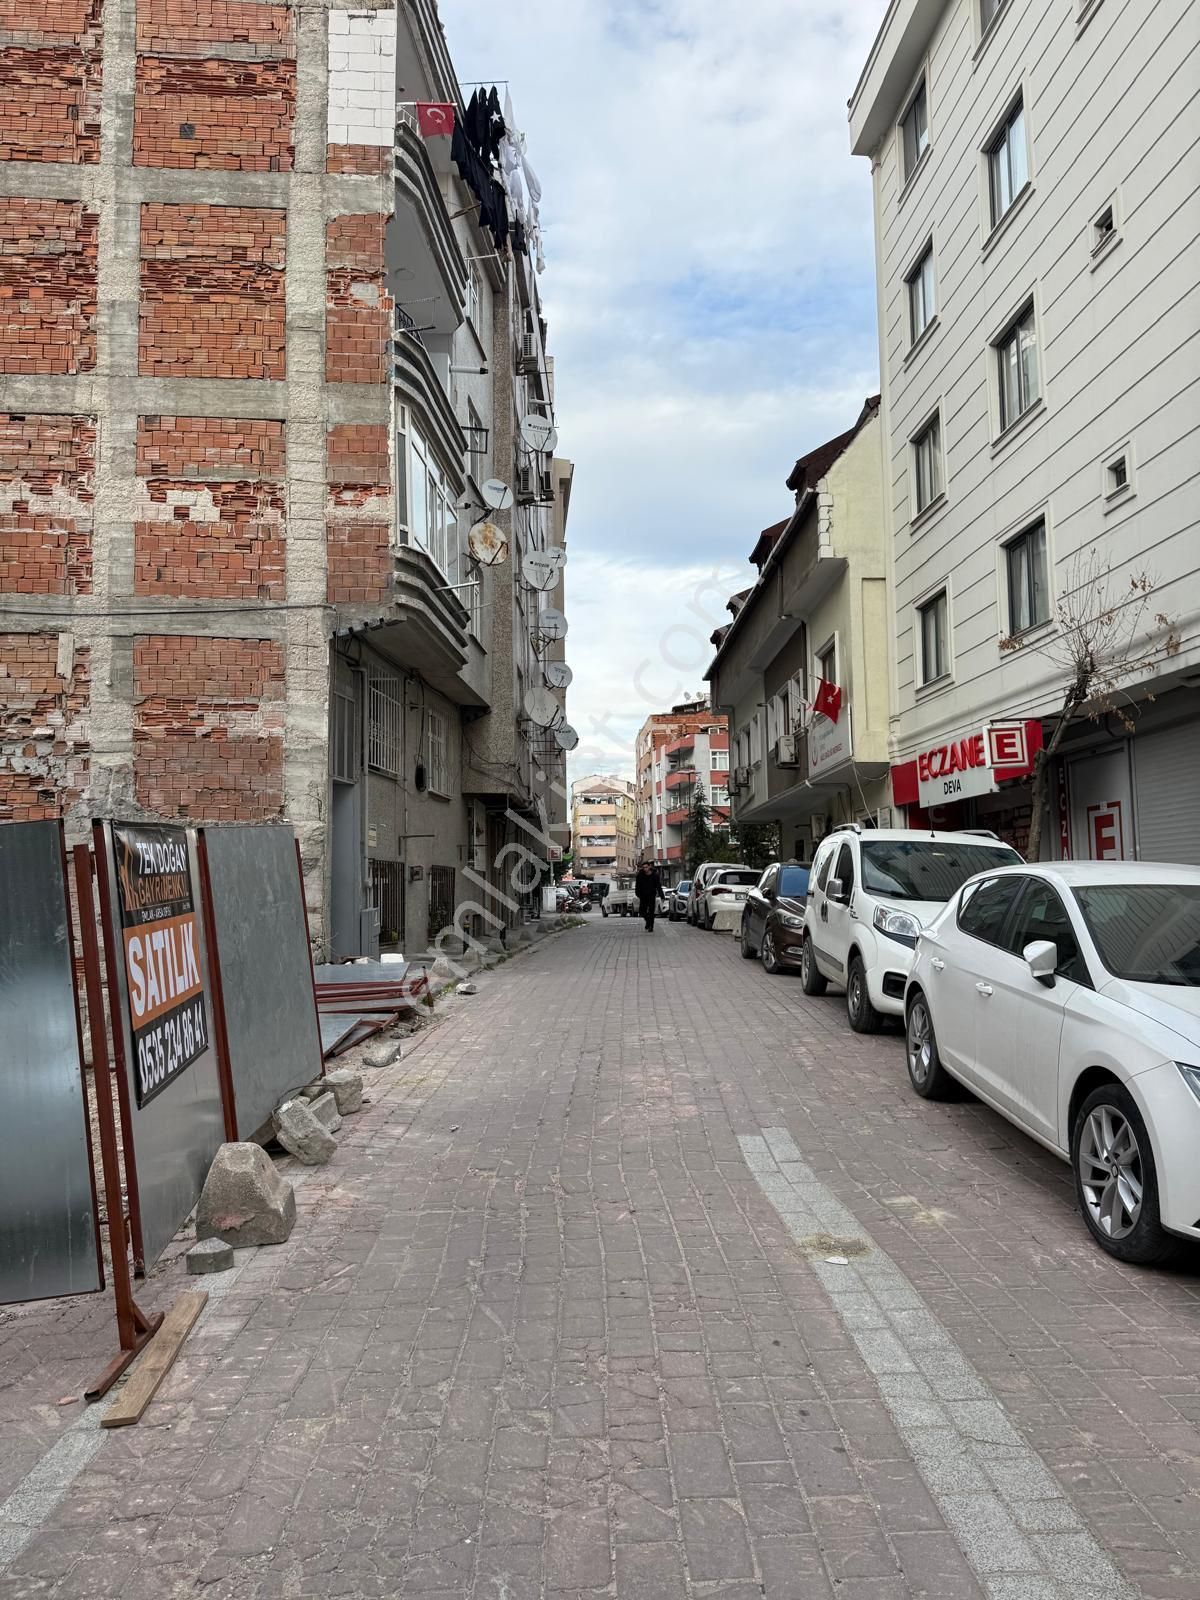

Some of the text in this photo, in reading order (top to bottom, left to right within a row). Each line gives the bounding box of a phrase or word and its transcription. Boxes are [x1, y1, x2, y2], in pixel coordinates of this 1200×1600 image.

[918, 733, 986, 782] ECZANE
[996, 733, 1018, 760] E
[943, 779, 962, 795] DEVA
[136, 838, 187, 875] TEK DOĞAN
[128, 922, 200, 1017] SATILIK
[138, 1027, 165, 1094] 0535
[164, 1014, 183, 1074] 234
[182, 1007, 195, 1059] 86
